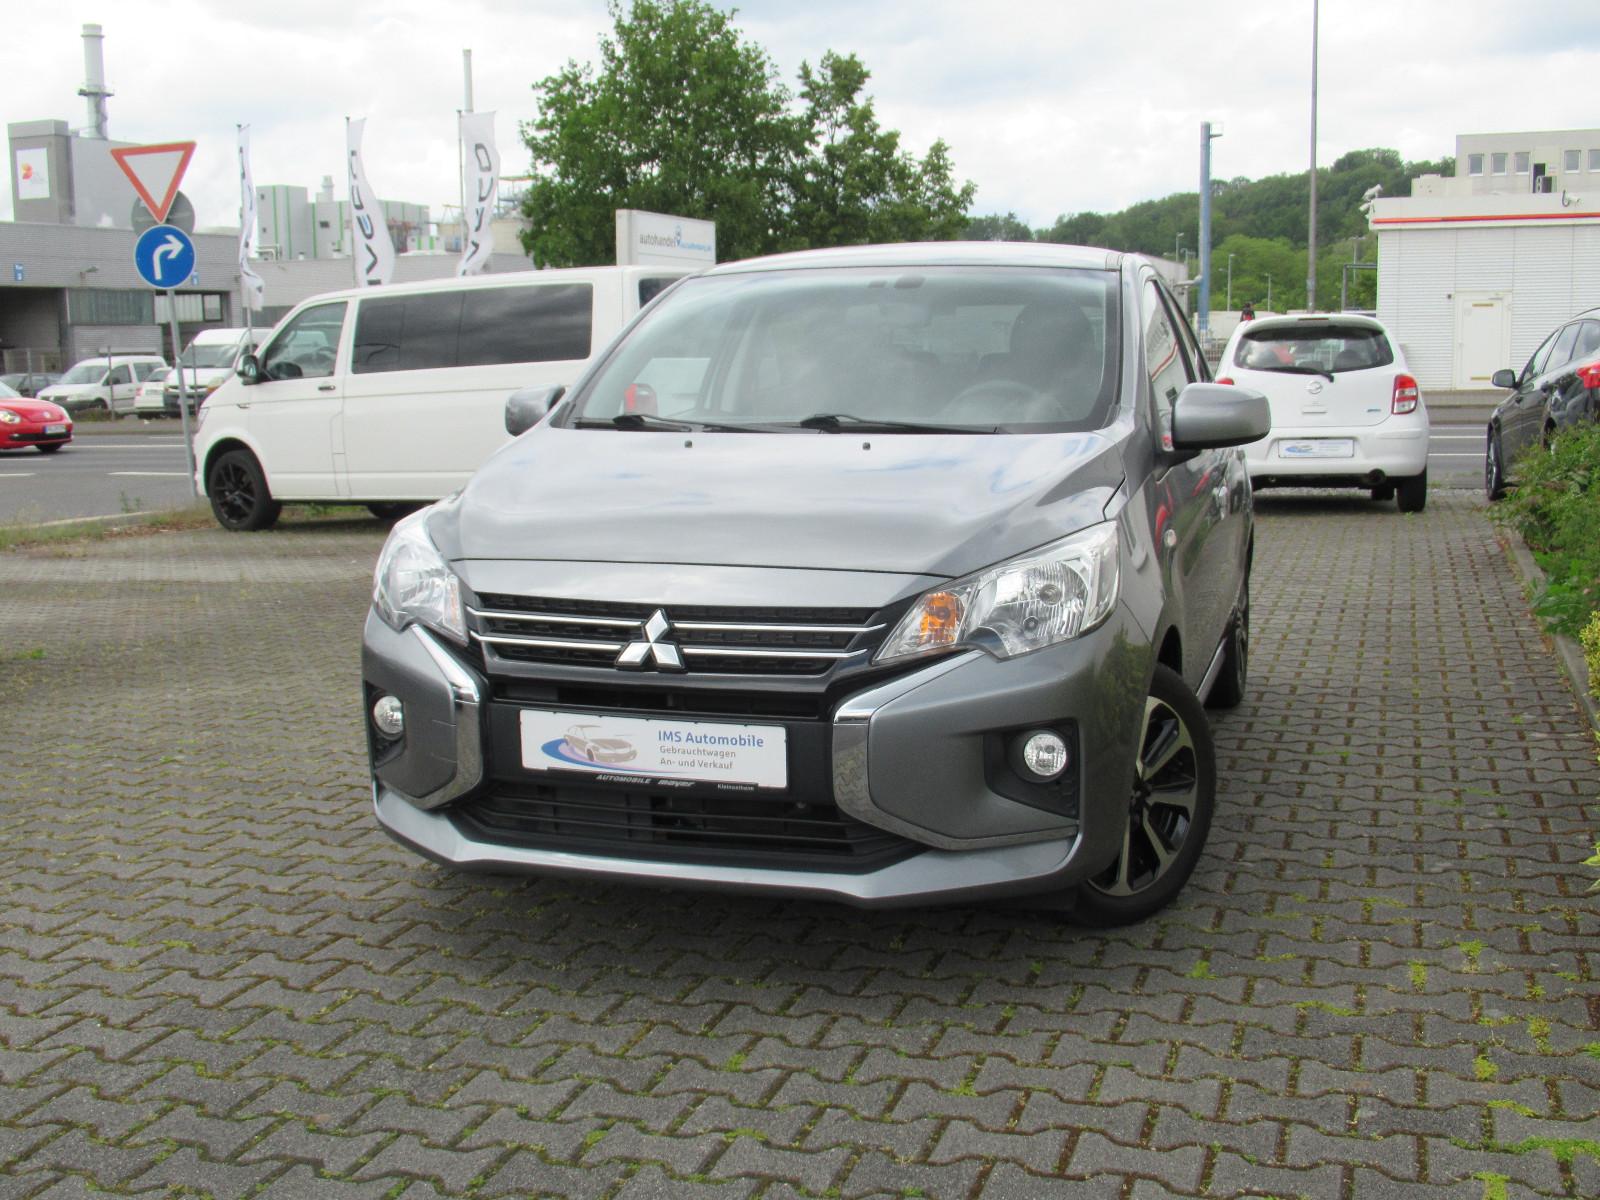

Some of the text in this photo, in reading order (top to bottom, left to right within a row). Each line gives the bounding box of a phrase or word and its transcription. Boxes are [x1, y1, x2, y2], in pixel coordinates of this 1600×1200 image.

[658, 730, 765, 748] IMS Automobile
[659, 744, 737, 759] Gebrauchtwagen
[660, 757, 734, 770] An- und Verkauf
[596, 774, 652, 785] AUTOMOBILE
